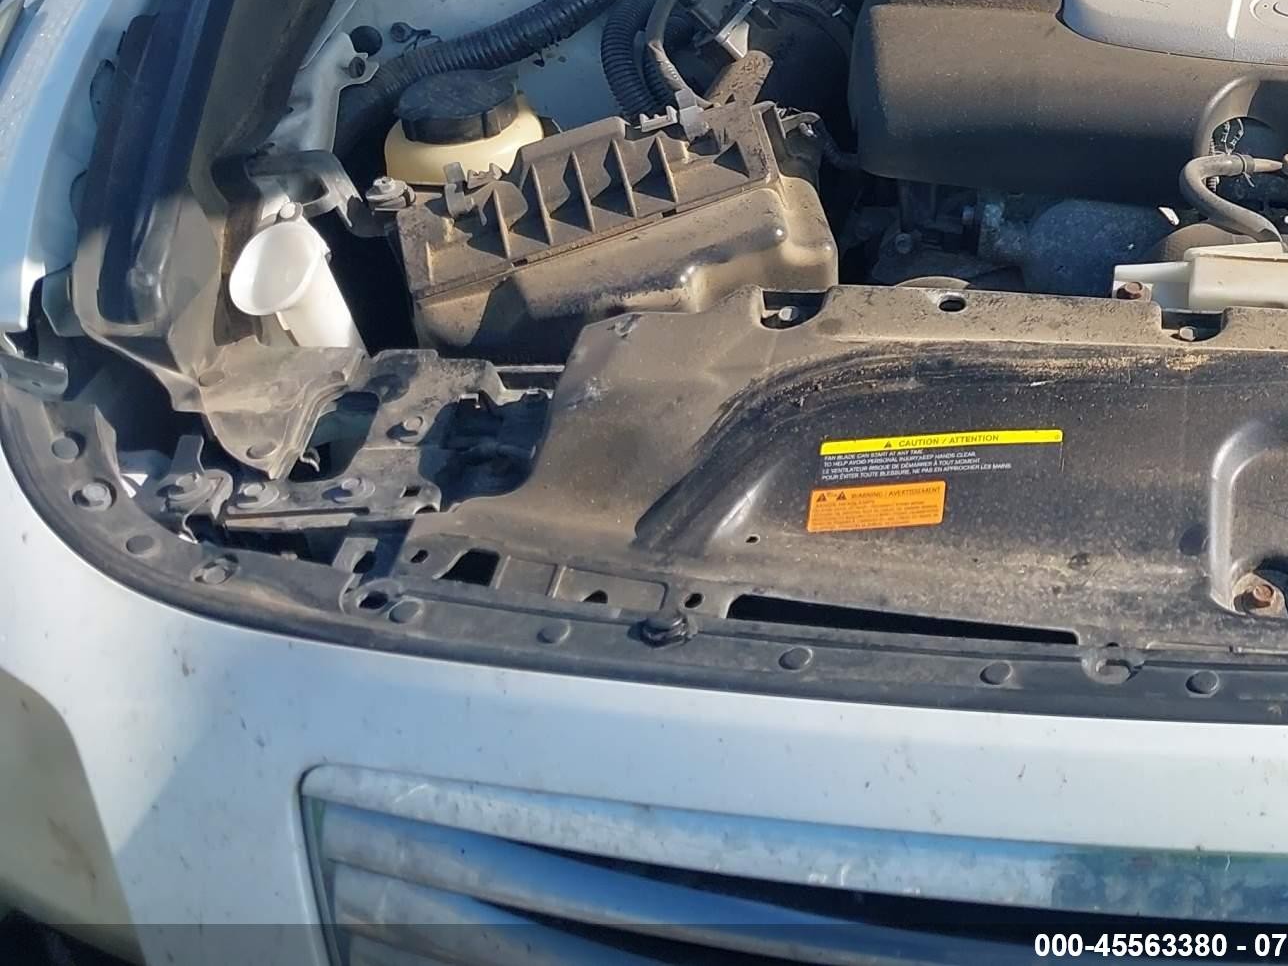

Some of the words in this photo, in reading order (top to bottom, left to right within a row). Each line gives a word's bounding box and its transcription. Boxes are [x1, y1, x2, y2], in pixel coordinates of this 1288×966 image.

[899, 437, 939, 447] CAUTION
[949, 434, 999, 444] ATTENTION
[867, 457, 898, 465] PERSONAL
[821, 473, 839, 481] POUR
